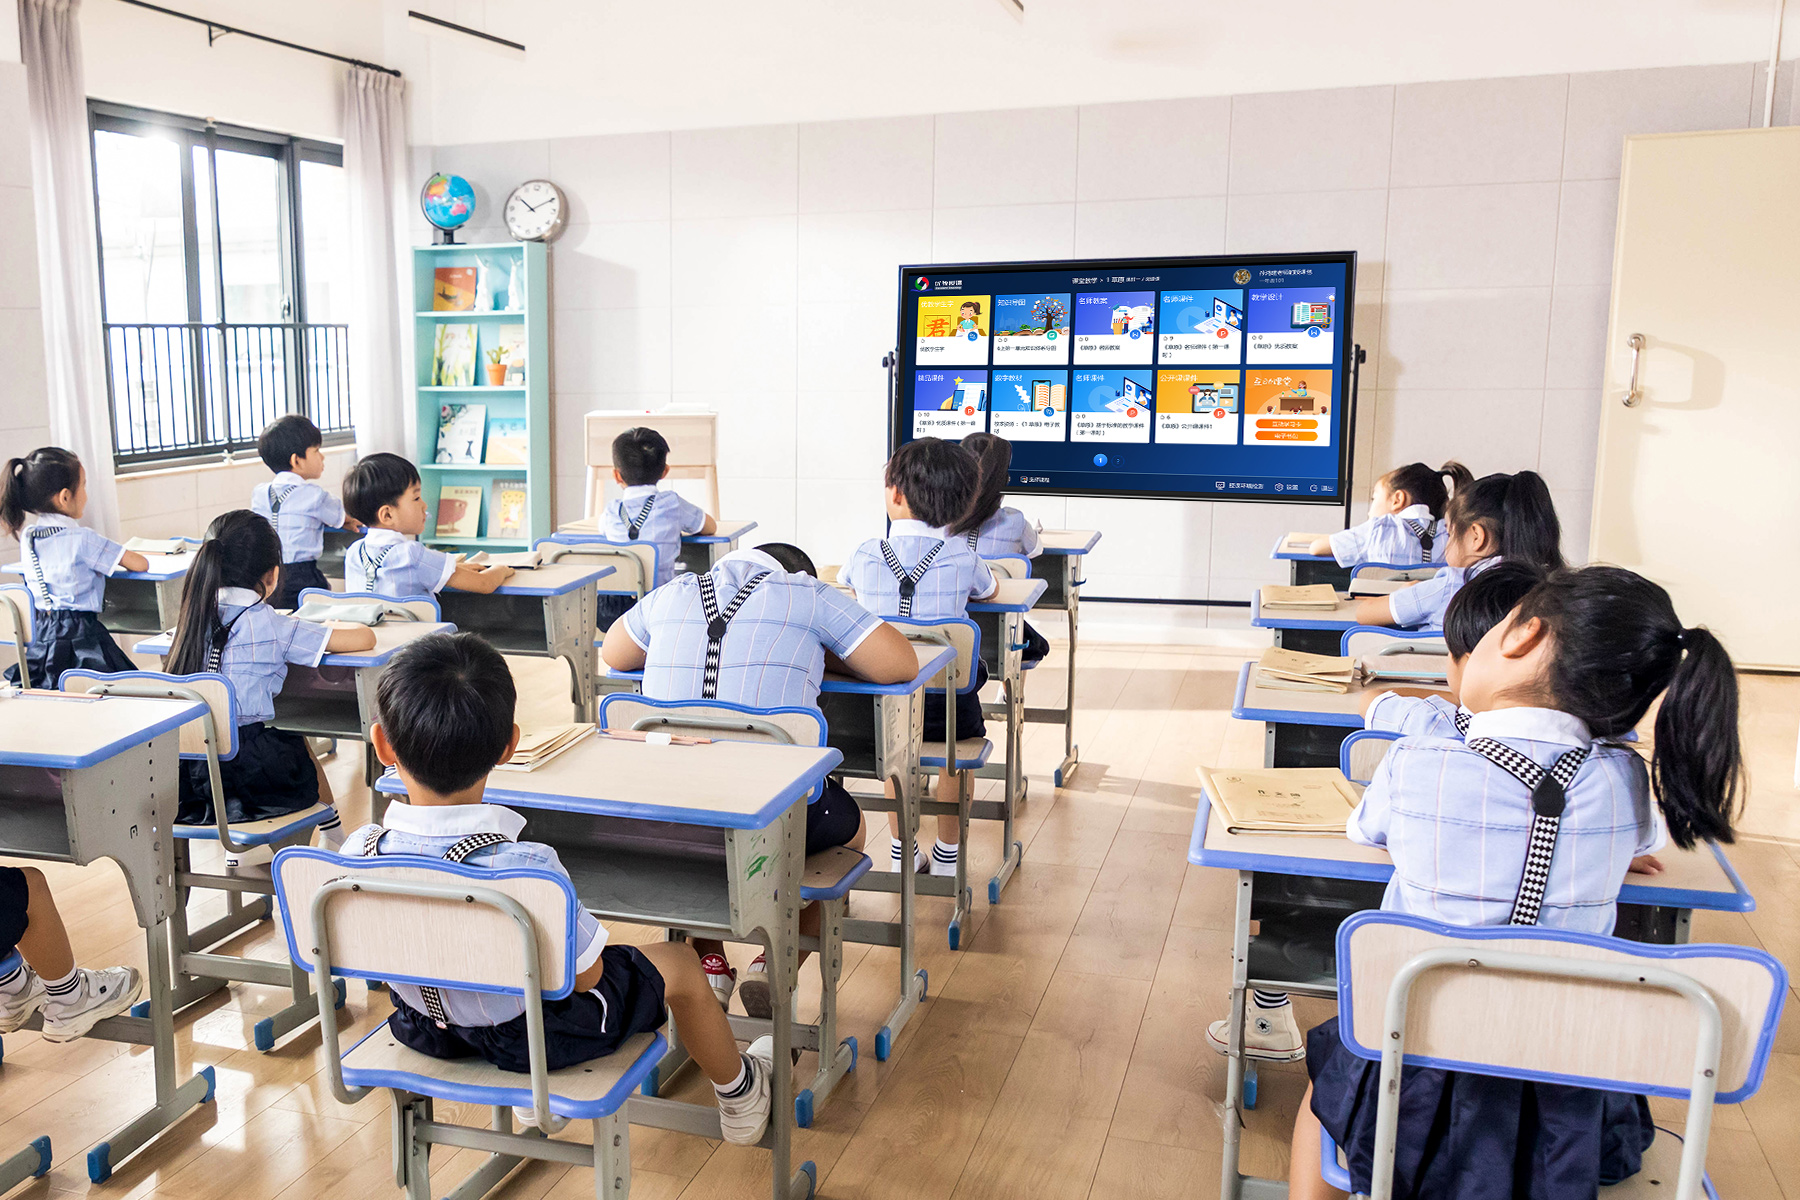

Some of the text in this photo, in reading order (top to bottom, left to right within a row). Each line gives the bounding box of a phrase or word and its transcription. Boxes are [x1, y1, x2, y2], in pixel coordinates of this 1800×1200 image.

[1078, 297, 1108, 305] 名师教案
[1163, 295, 1194, 303] 名师课件
[1251, 293, 1283, 302] 教学设计
[926, 318, 950, 337] 君
[918, 374, 944, 382] 精品课件
[994, 374, 1023, 382] 数字教材
[1075, 374, 1105, 382] 名师课件
[1253, 376, 1293, 386] 互动课堂
